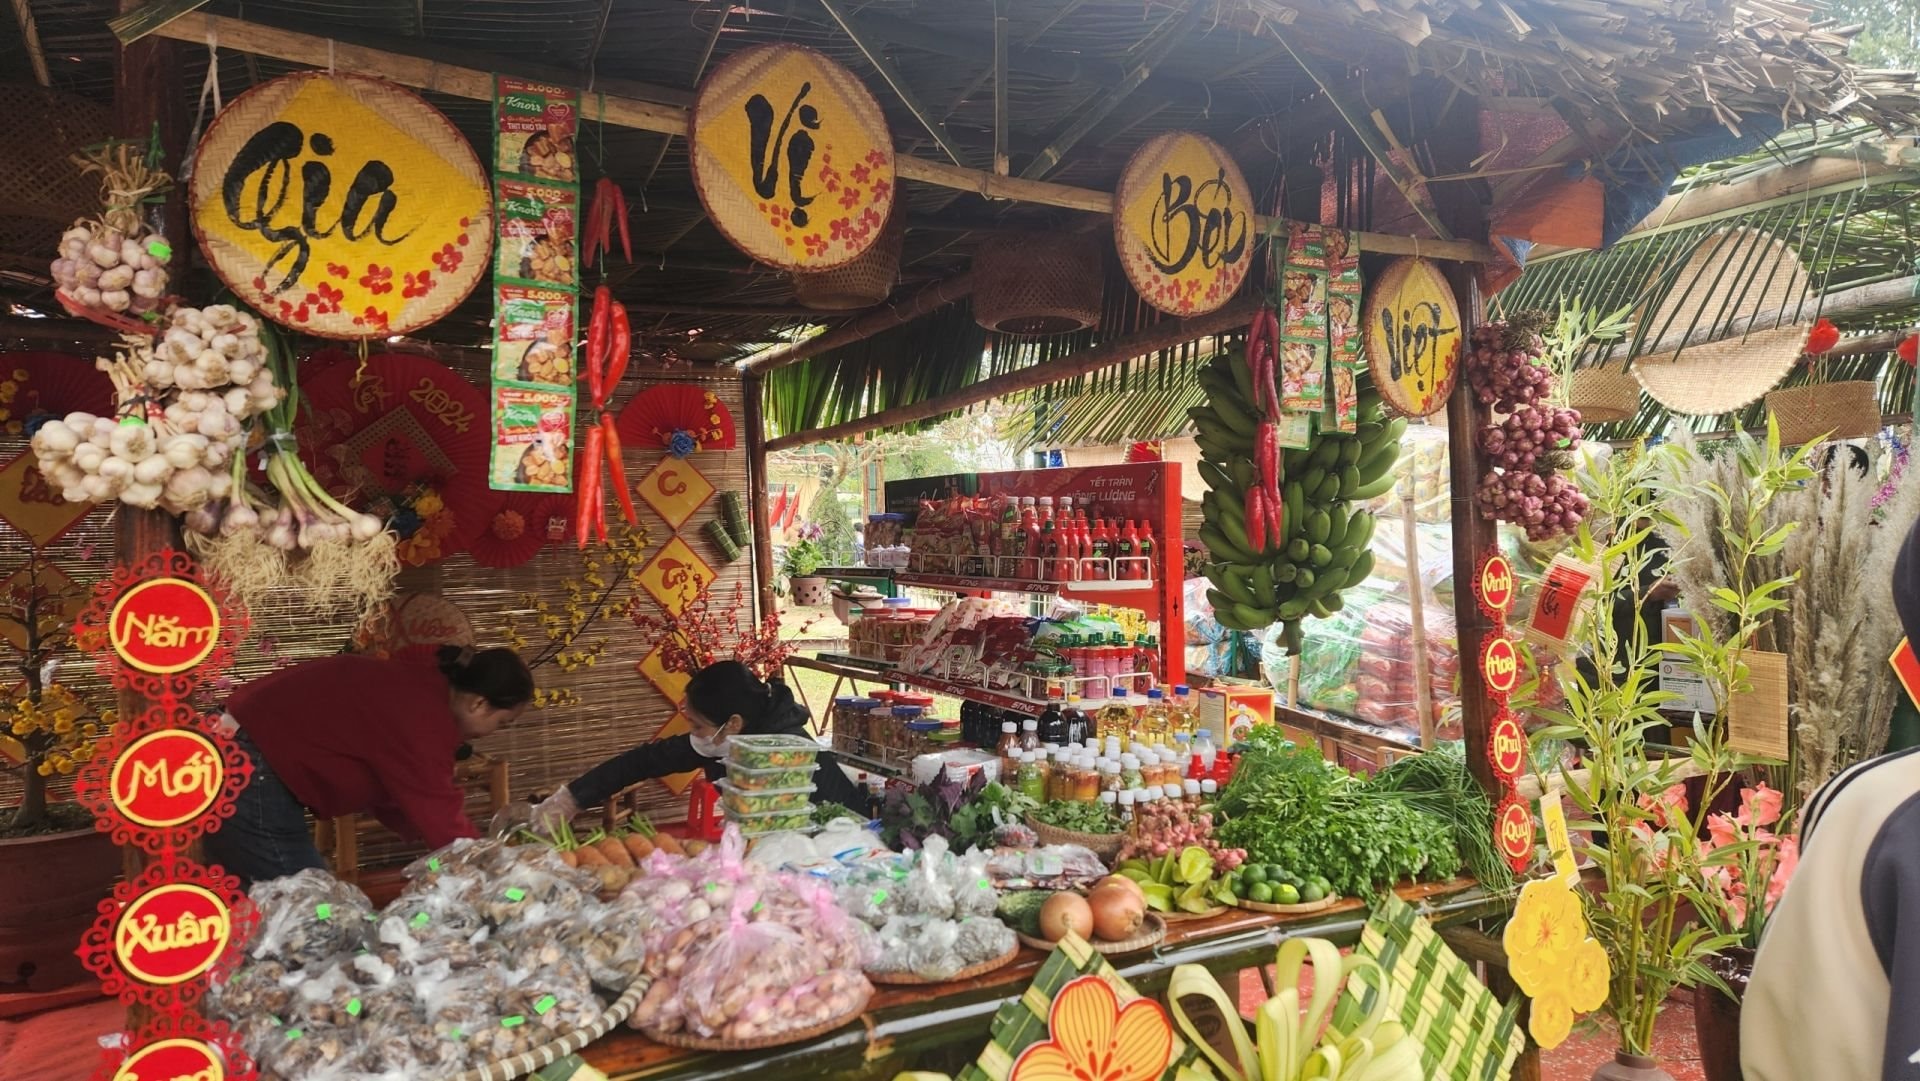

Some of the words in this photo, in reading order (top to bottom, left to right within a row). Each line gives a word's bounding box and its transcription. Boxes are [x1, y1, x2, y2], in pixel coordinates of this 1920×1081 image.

[506, 96, 542, 113] Knorr
[744, 81, 824, 228] Vị
[222, 120, 420, 298] Gia
[506, 200, 542, 217] Knorr
[1381, 299, 1458, 394] Việt
[1090, 477, 1107, 487] TẾT
[1109, 475, 1134, 486] TRÀN
[1099, 489, 1136, 504] LƯỢNG
[1025, 583, 1050, 592] STING
[117, 611, 213, 647] Năm
[945, 685, 966, 696] STING
[1011, 701, 1035, 713] STING
[119, 750, 216, 807] Mới
[123, 911, 223, 958] Xuân
